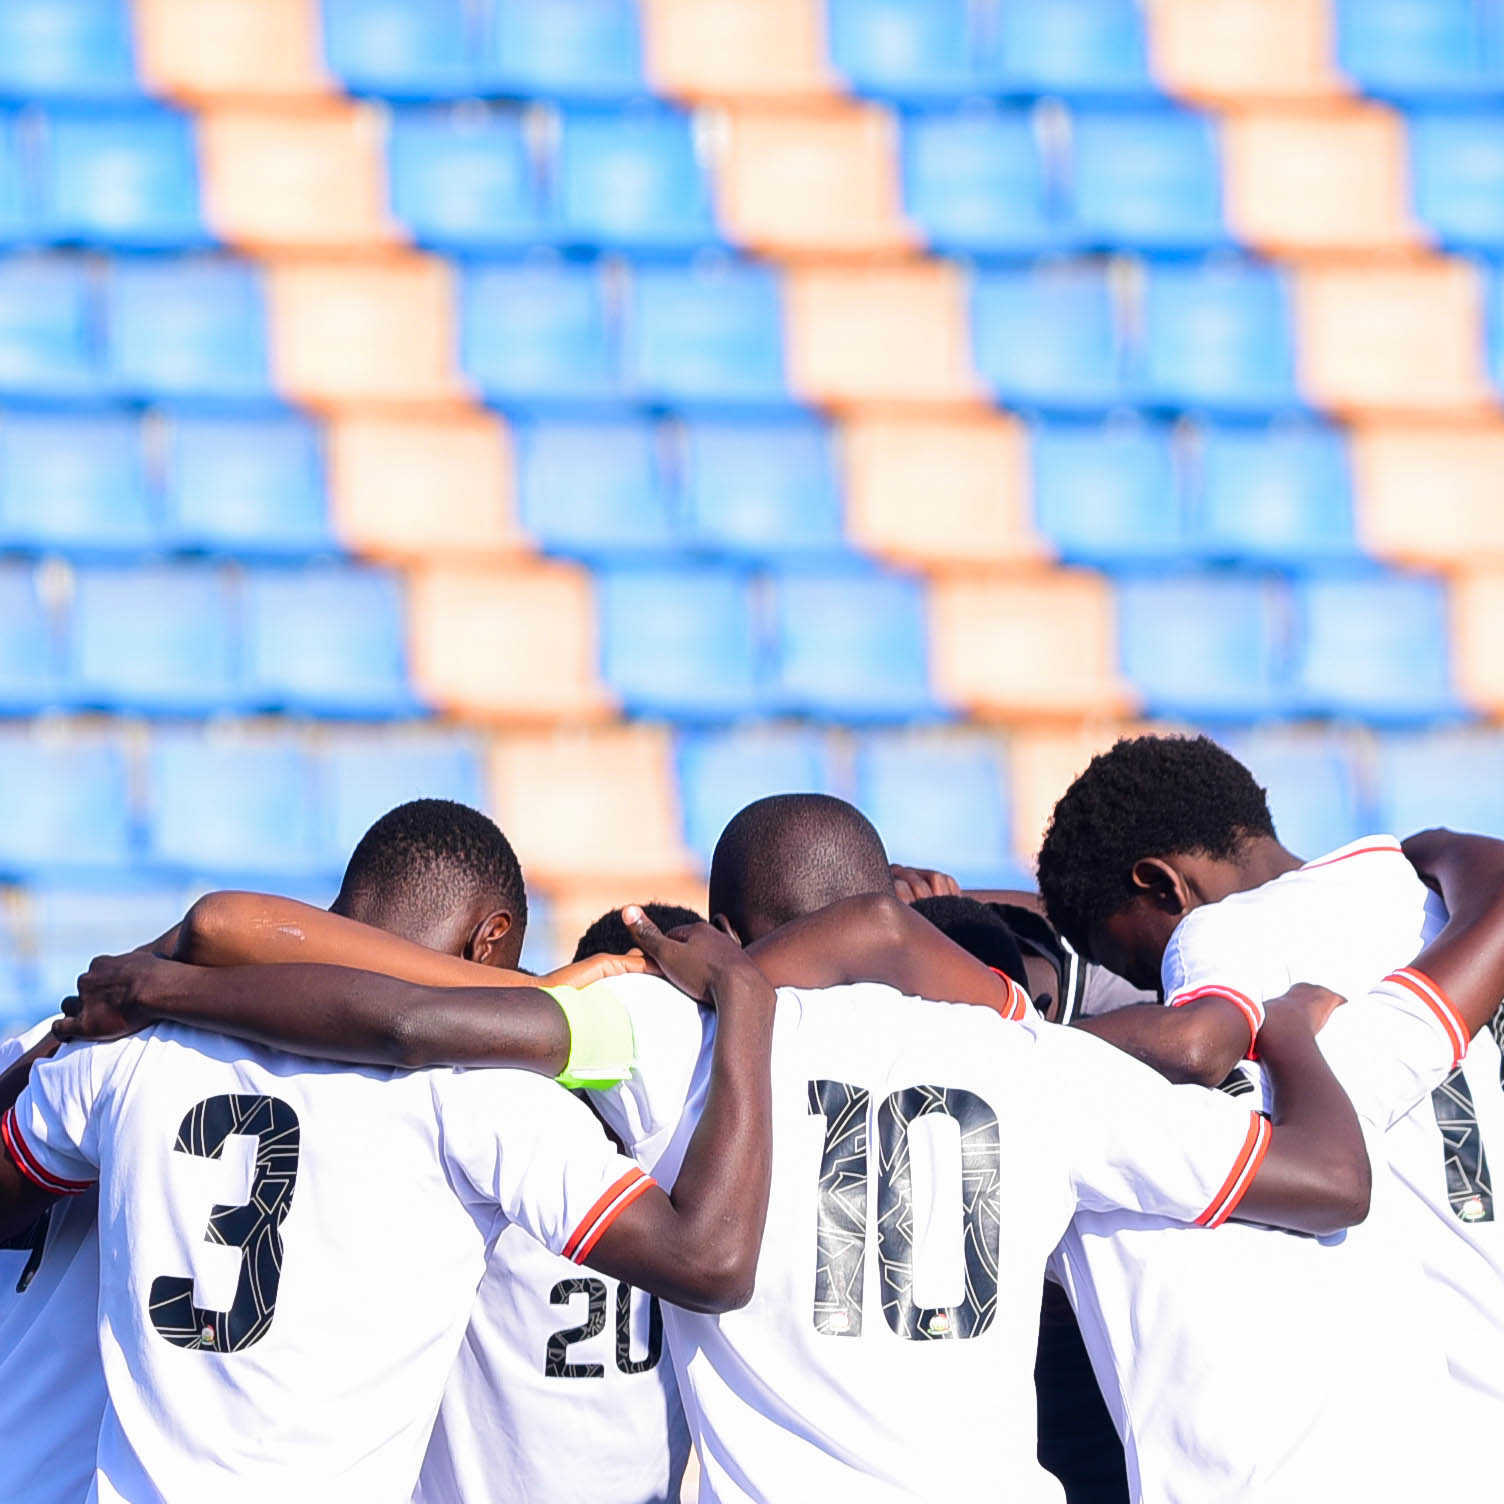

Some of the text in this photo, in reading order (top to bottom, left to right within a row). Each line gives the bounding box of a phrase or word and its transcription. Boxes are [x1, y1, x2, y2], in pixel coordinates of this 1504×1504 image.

[149, 1093, 301, 1353] 3
[545, 1277, 664, 1379] 20
[808, 1079, 1001, 1341] 10
